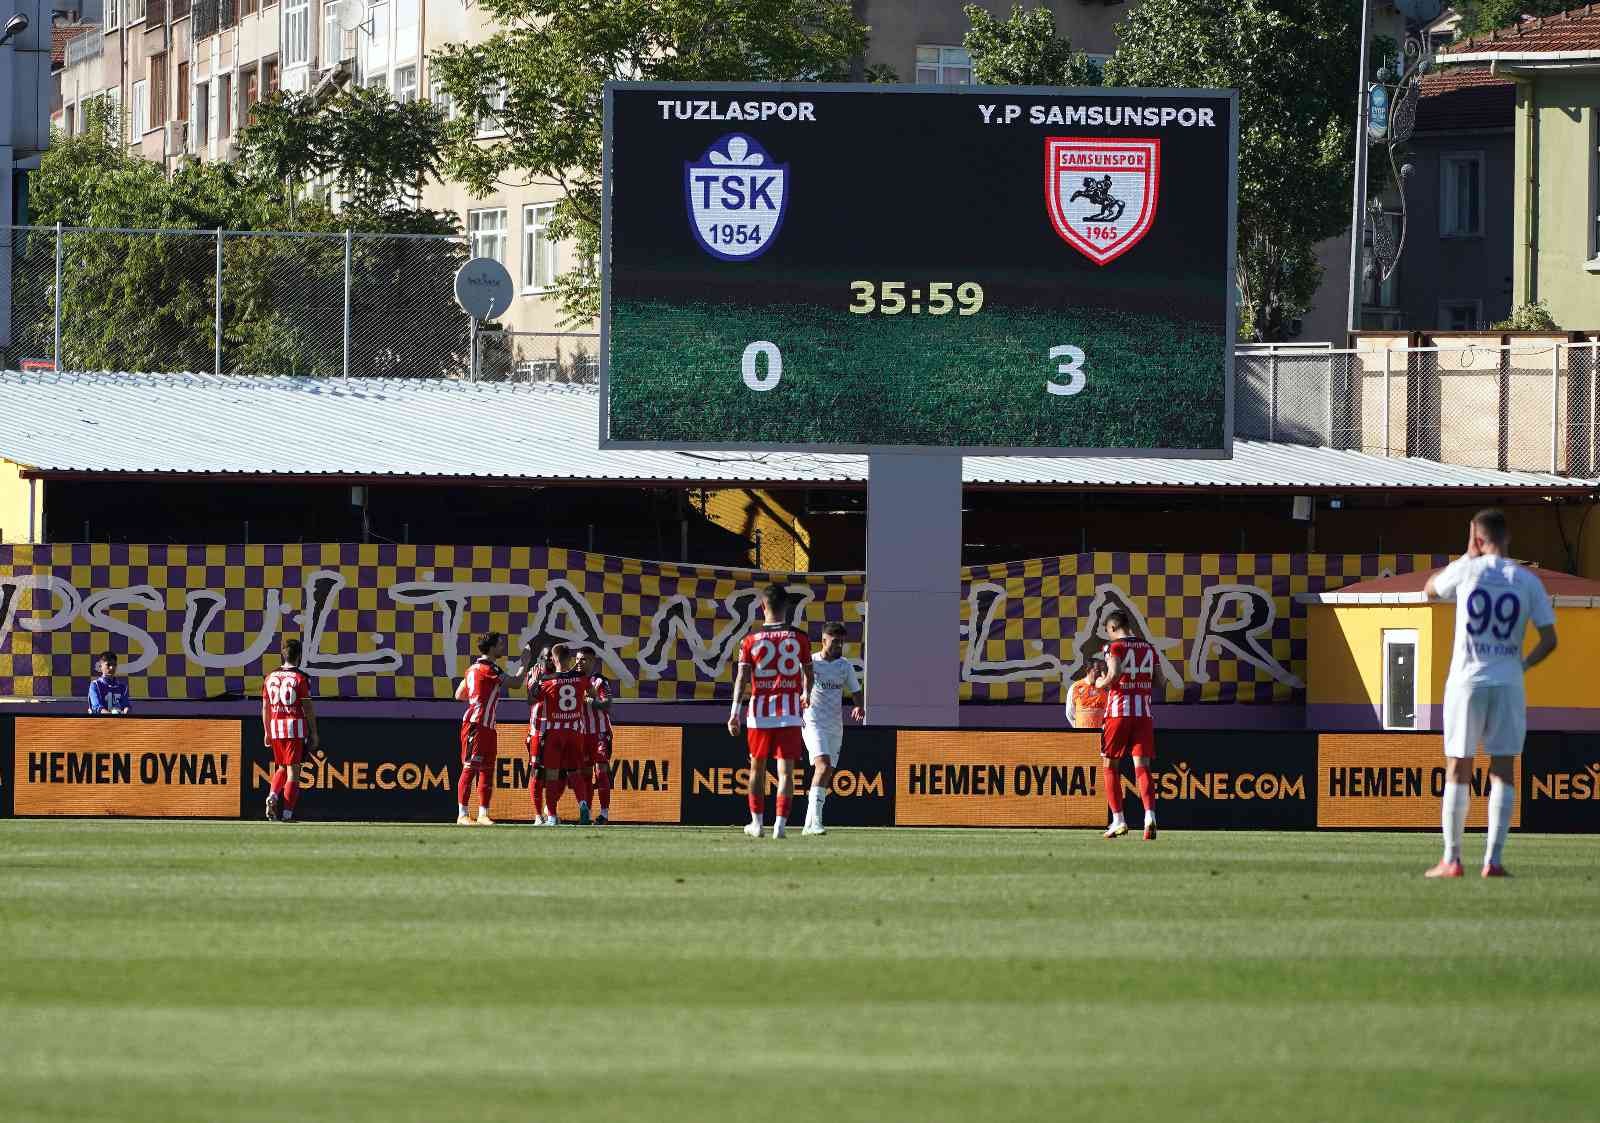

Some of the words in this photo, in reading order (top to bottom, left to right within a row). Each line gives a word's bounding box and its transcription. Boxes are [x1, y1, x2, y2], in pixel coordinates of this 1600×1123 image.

[658, 99, 817, 122] TUZLASPOR
[978, 104, 1022, 126] Y.P
[1029, 104, 1216, 128] SAMSUNSPOR
[1060, 152, 1145, 167] SAMSUNSPOR
[694, 174, 777, 211] TSK
[708, 223, 762, 246] 1954
[1085, 225, 1118, 241] 1965
[848, 280, 984, 316] 35:59
[740, 339, 784, 392] 0
[1046, 344, 1088, 397] 3
[1466, 588, 1521, 640] 99
[750, 638, 801, 678] 28
[1120, 647, 1154, 681] 44
[558, 684, 577, 712] 8
[28, 751, 131, 784] HEMEN
[139, 752, 228, 785] OYNA!
[252, 750, 450, 791] NSINE.COM
[908, 764, 1005, 795] HEMEN
[1013, 764, 1096, 796] OYNA!
[1329, 767, 1422, 797] HEMEN
